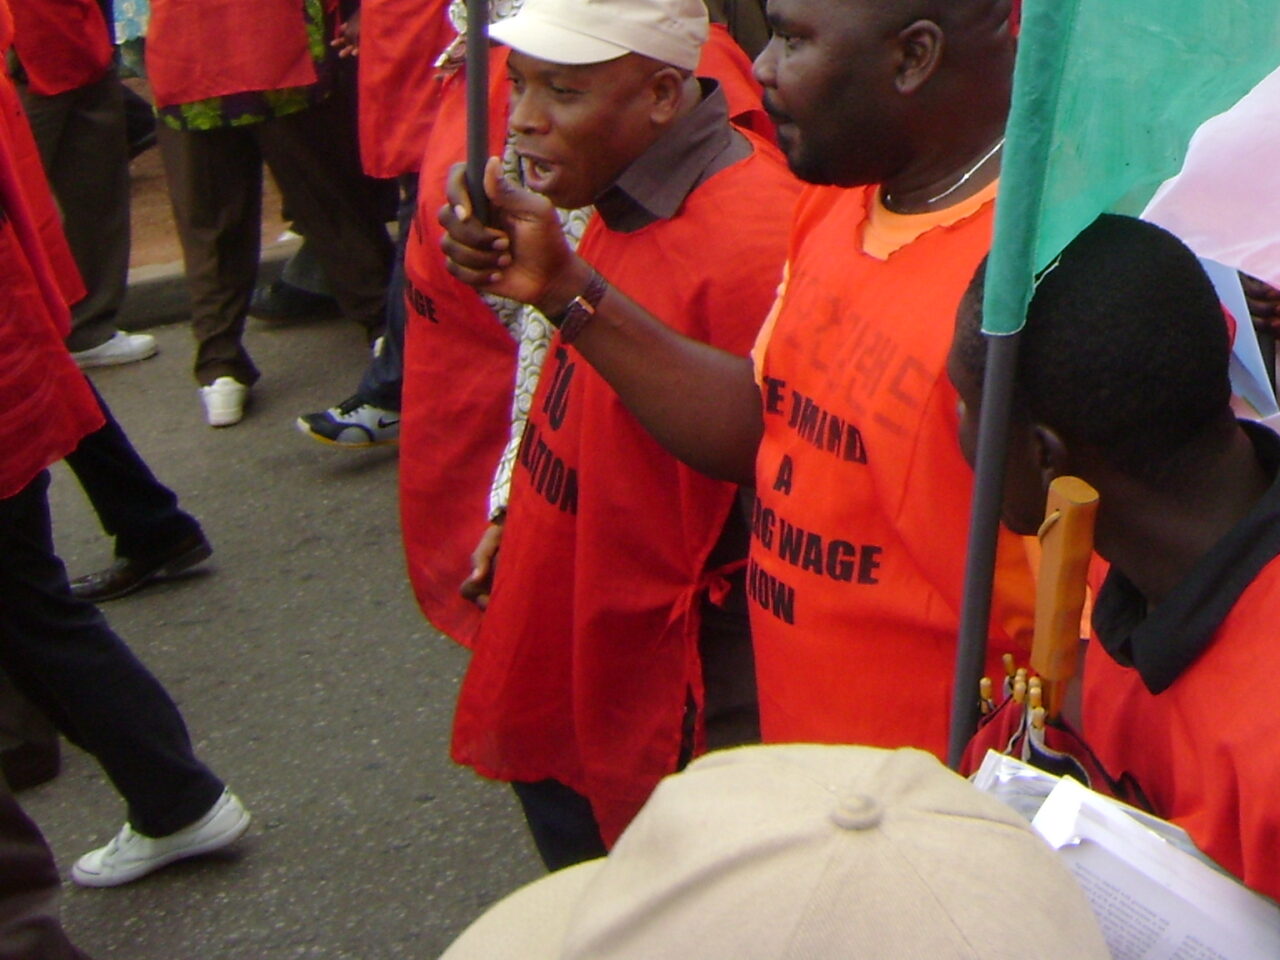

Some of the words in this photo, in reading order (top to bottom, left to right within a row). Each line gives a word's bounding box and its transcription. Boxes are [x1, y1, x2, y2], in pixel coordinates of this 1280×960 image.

[763, 375, 787, 416] E
[772, 453, 794, 496] A
[777, 517, 884, 586] WAGE
[747, 558, 796, 626] NOW
